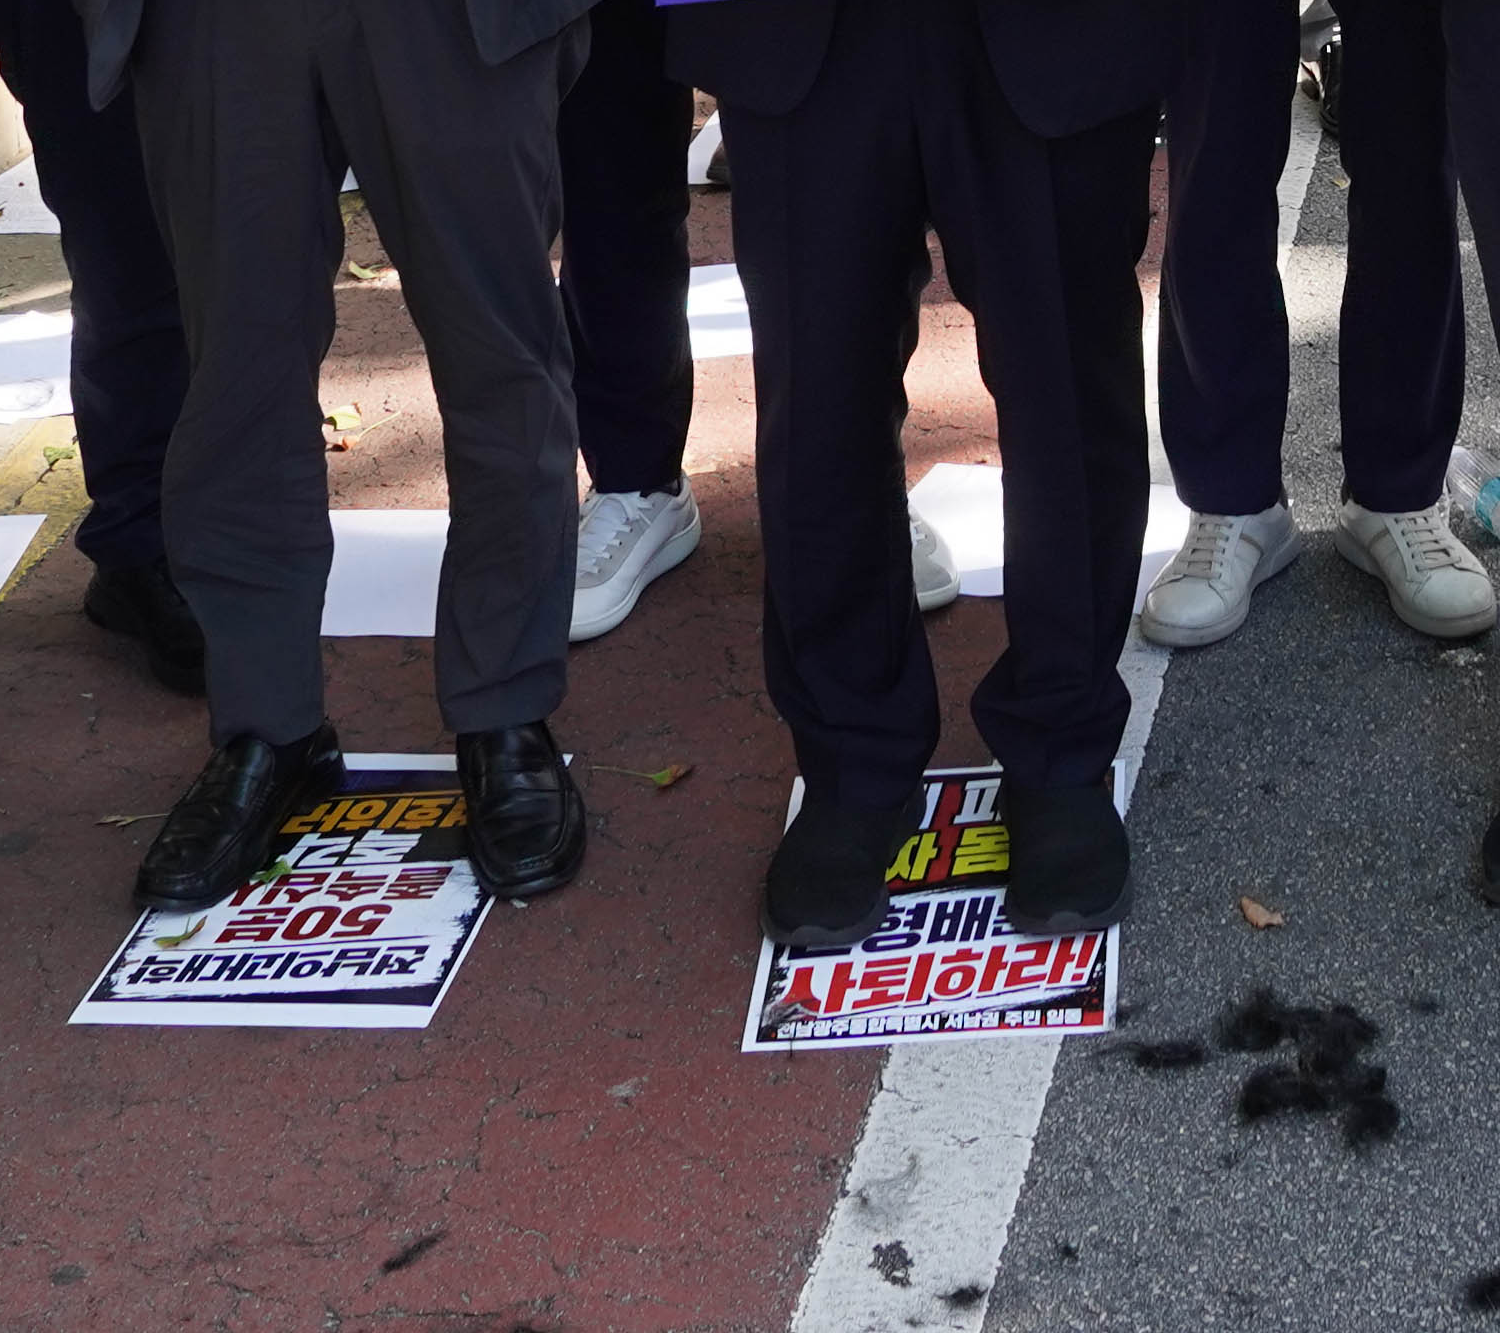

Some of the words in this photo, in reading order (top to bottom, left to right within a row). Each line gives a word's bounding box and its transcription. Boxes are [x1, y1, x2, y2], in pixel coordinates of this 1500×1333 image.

[215, 904, 392, 944] 50분
[127, 945, 430, 985] 전남의과대학
[783, 935, 1100, 1014] 사퇴하라!
[944, 1011, 999, 1028] 서남권
[1004, 1010, 1040, 1027] 주민
[1046, 1009, 1082, 1025] 일동
